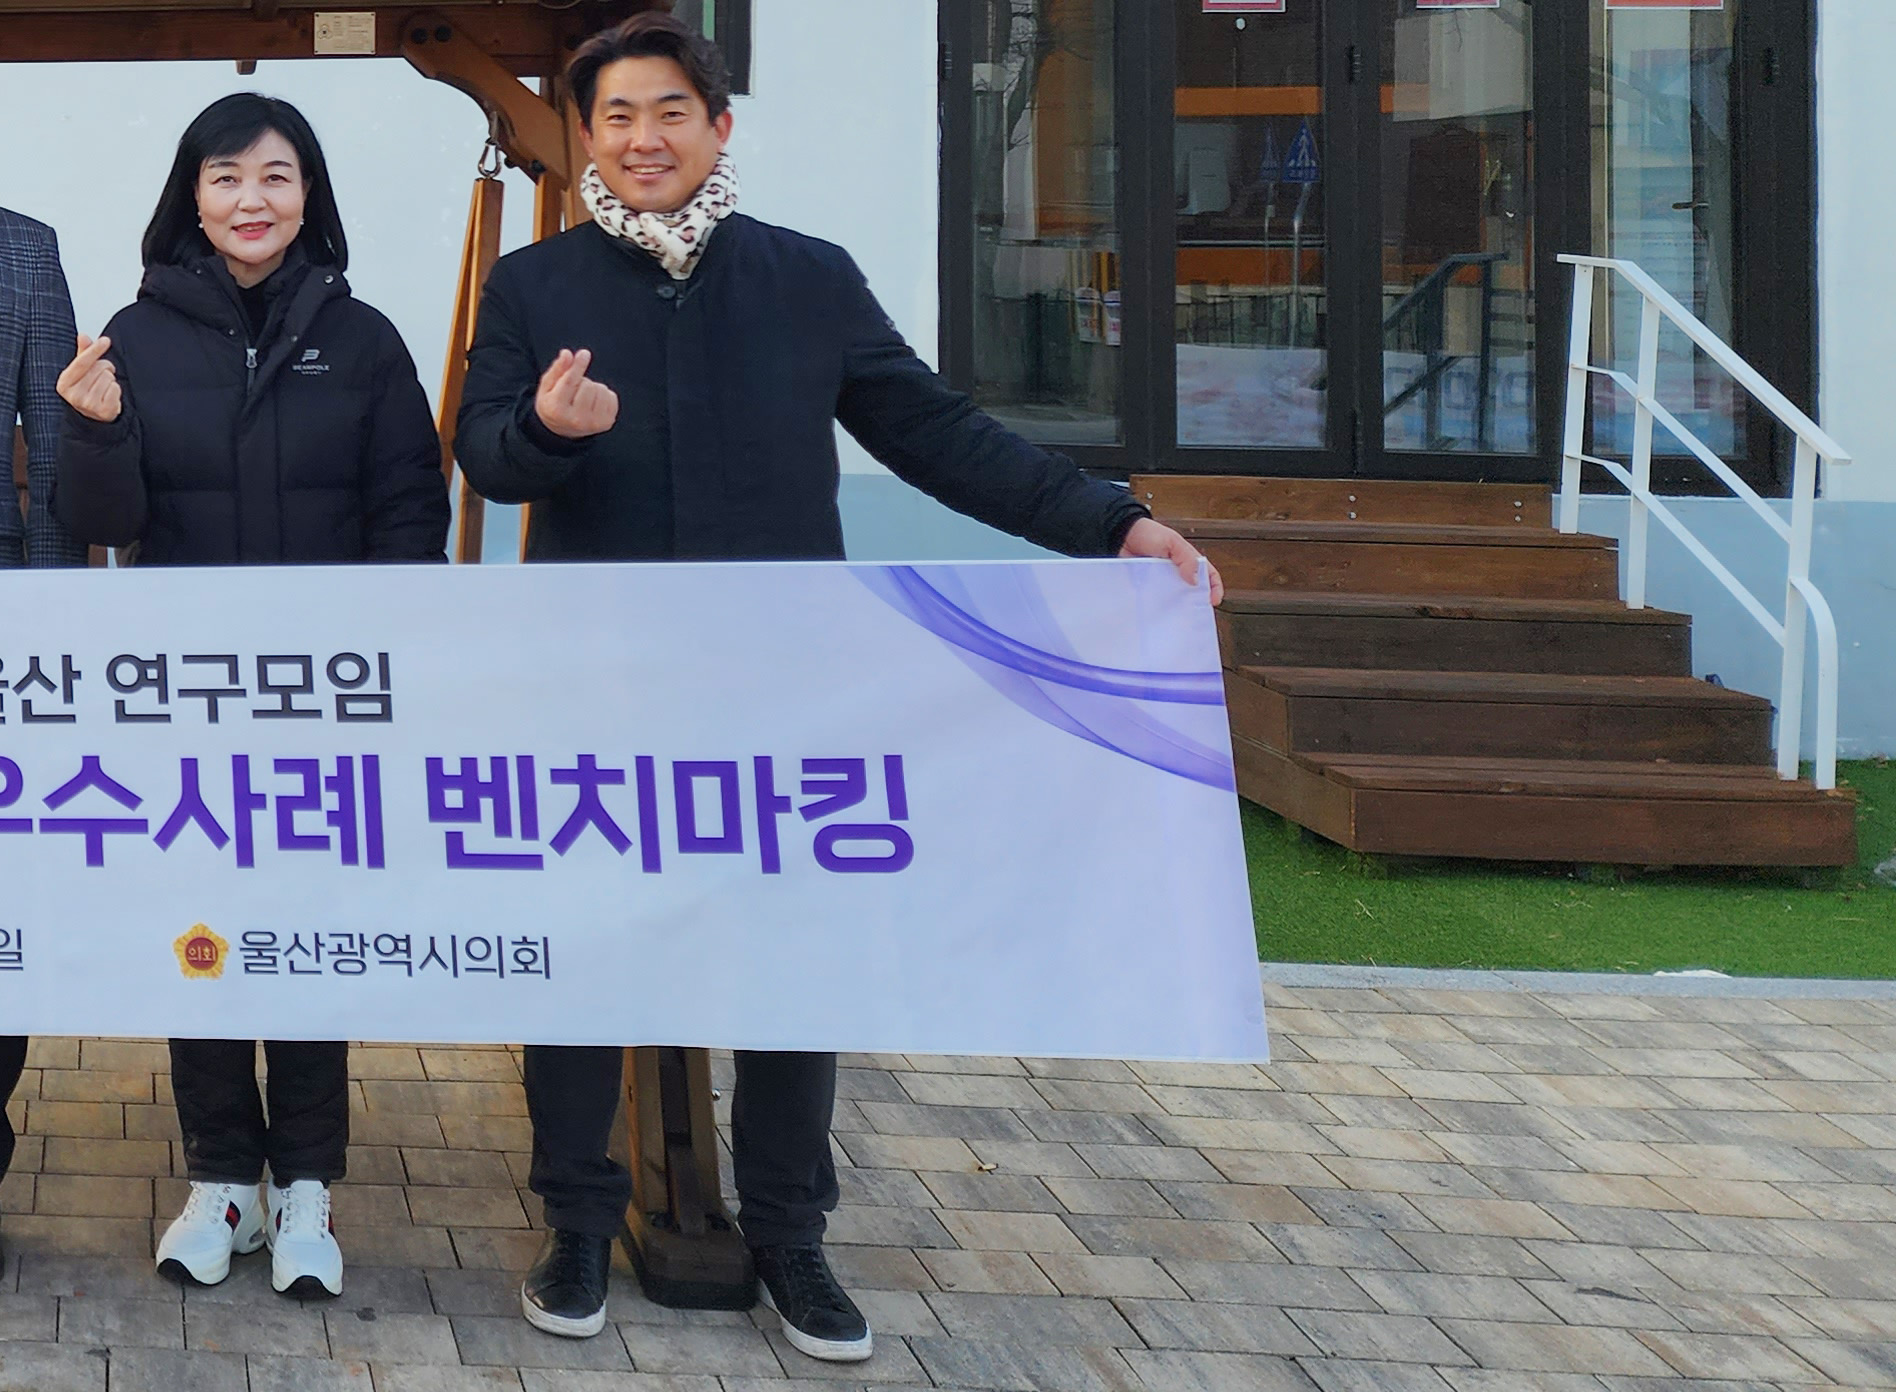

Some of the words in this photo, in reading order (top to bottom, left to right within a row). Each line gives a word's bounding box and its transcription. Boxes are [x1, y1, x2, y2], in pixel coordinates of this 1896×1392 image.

[104, 652, 394, 725] 연구모임
[424, 753, 915, 875] 벤치마킹
[239, 929, 552, 980] 울산광역시의회
